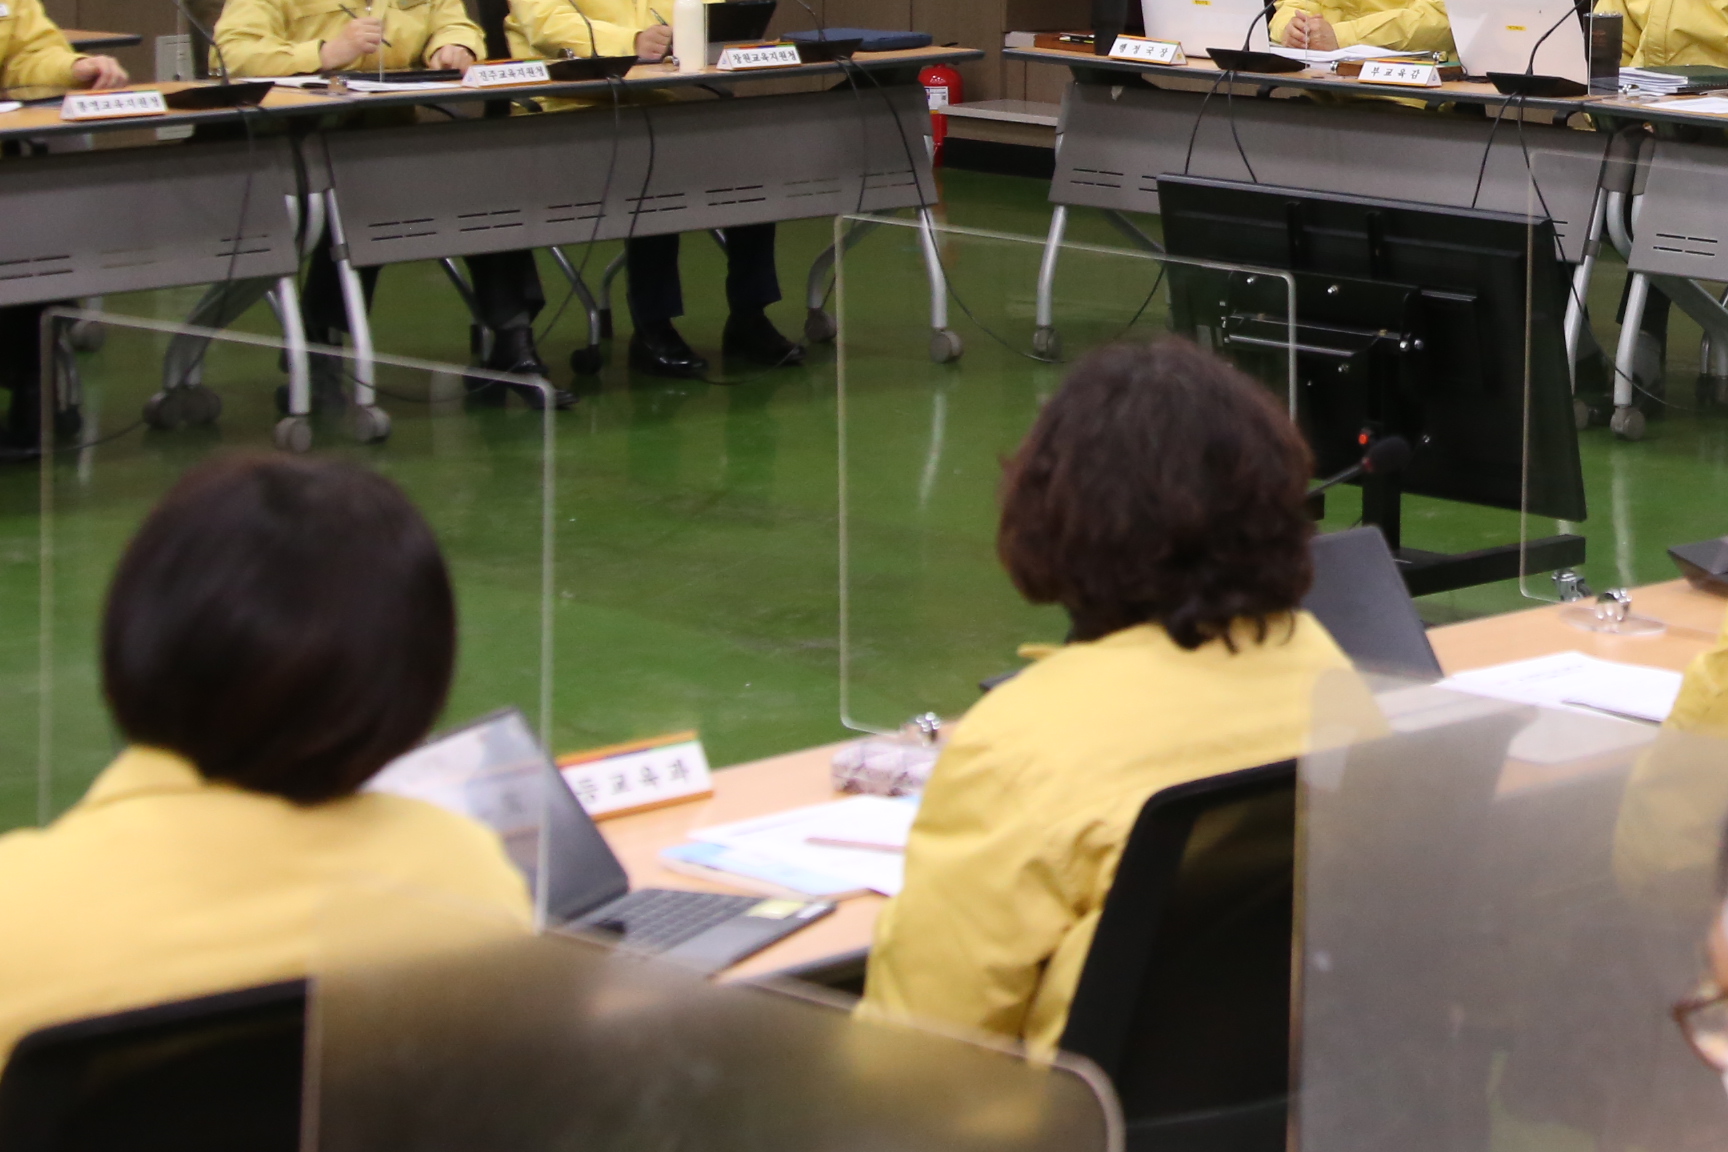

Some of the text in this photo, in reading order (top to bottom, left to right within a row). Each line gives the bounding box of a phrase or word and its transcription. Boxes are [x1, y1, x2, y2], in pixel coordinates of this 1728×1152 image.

[732, 49, 797, 65] 창원교육지원청
[1118, 42, 1169, 58] 행정국장
[1370, 66, 1421, 79] 부교육감
[576, 759, 690, 806] 등교육과
